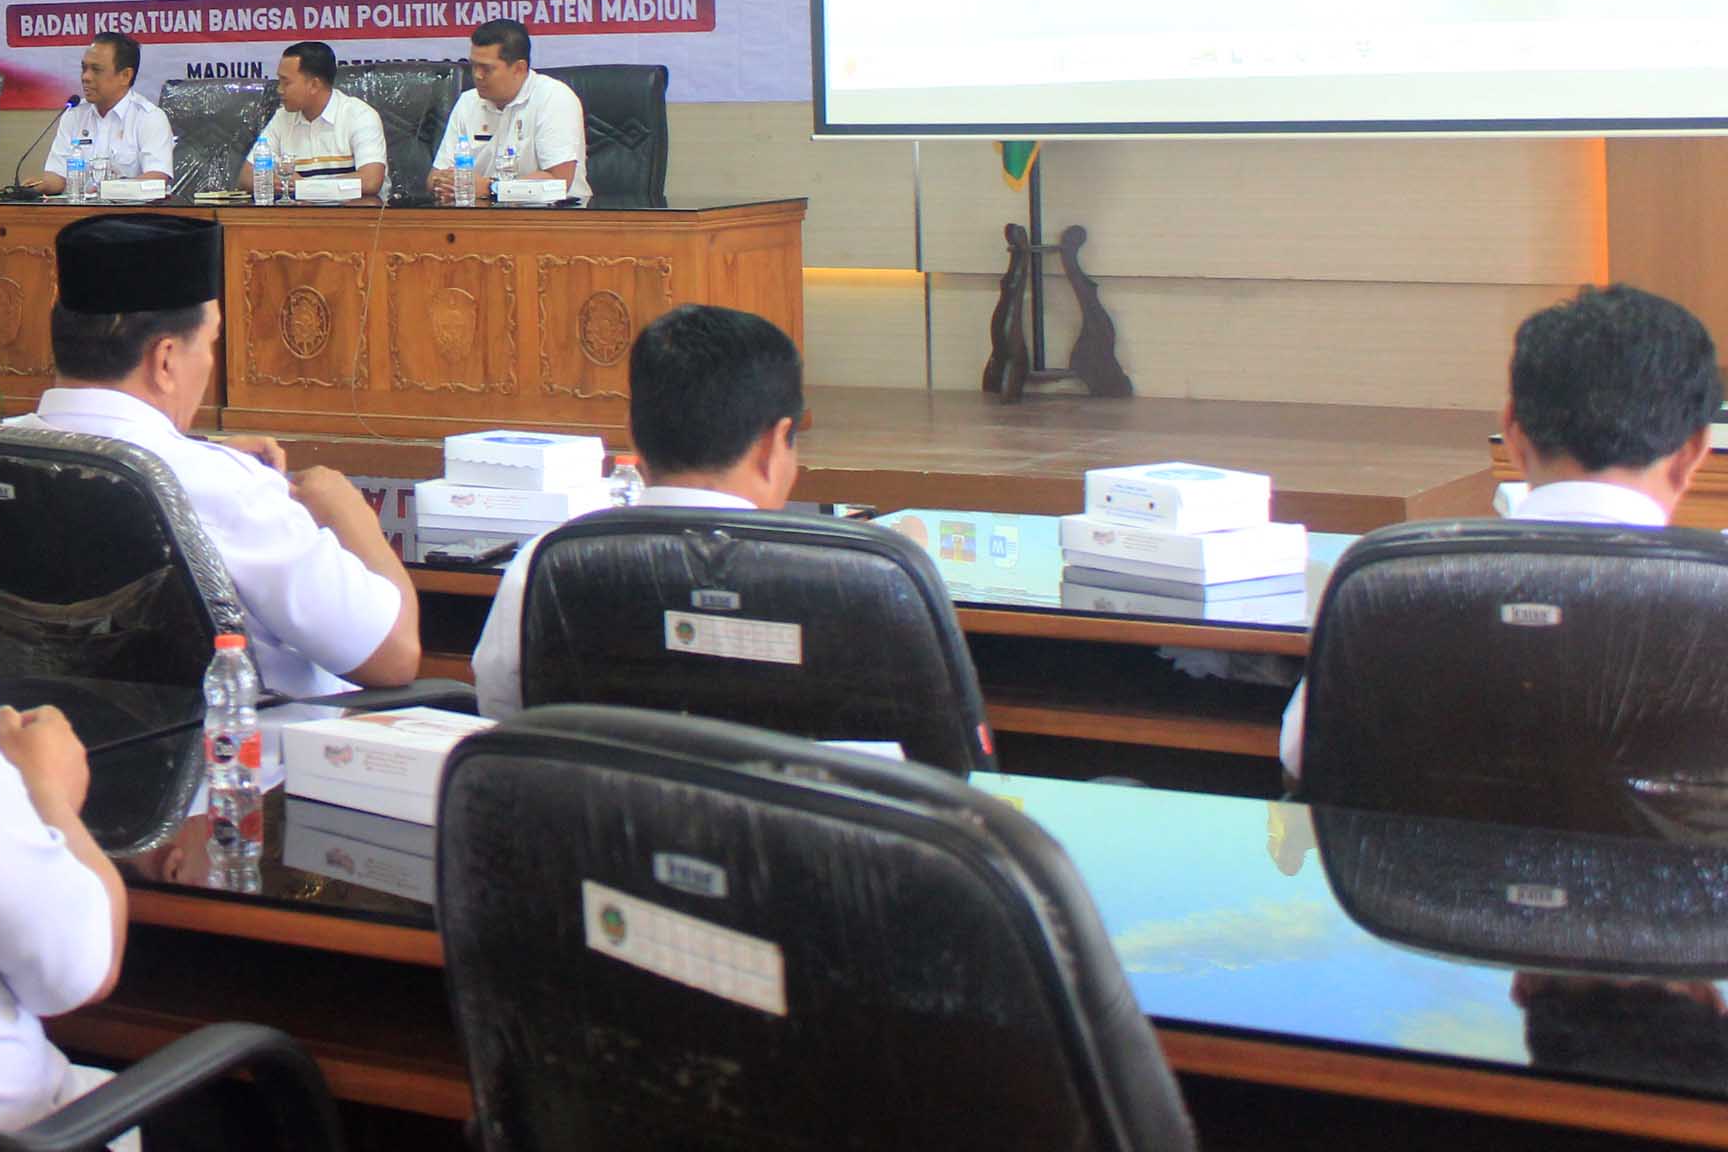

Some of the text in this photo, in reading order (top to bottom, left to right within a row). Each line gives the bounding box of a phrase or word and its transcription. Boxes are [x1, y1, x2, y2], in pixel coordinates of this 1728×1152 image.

[20, 11, 89, 37] BADAN
[94, 7, 202, 35] KESATUAN
[208, 6, 298, 32] BANGSA
[304, 5, 349, 29] DAN
[357, 0, 447, 28] POLITIK
